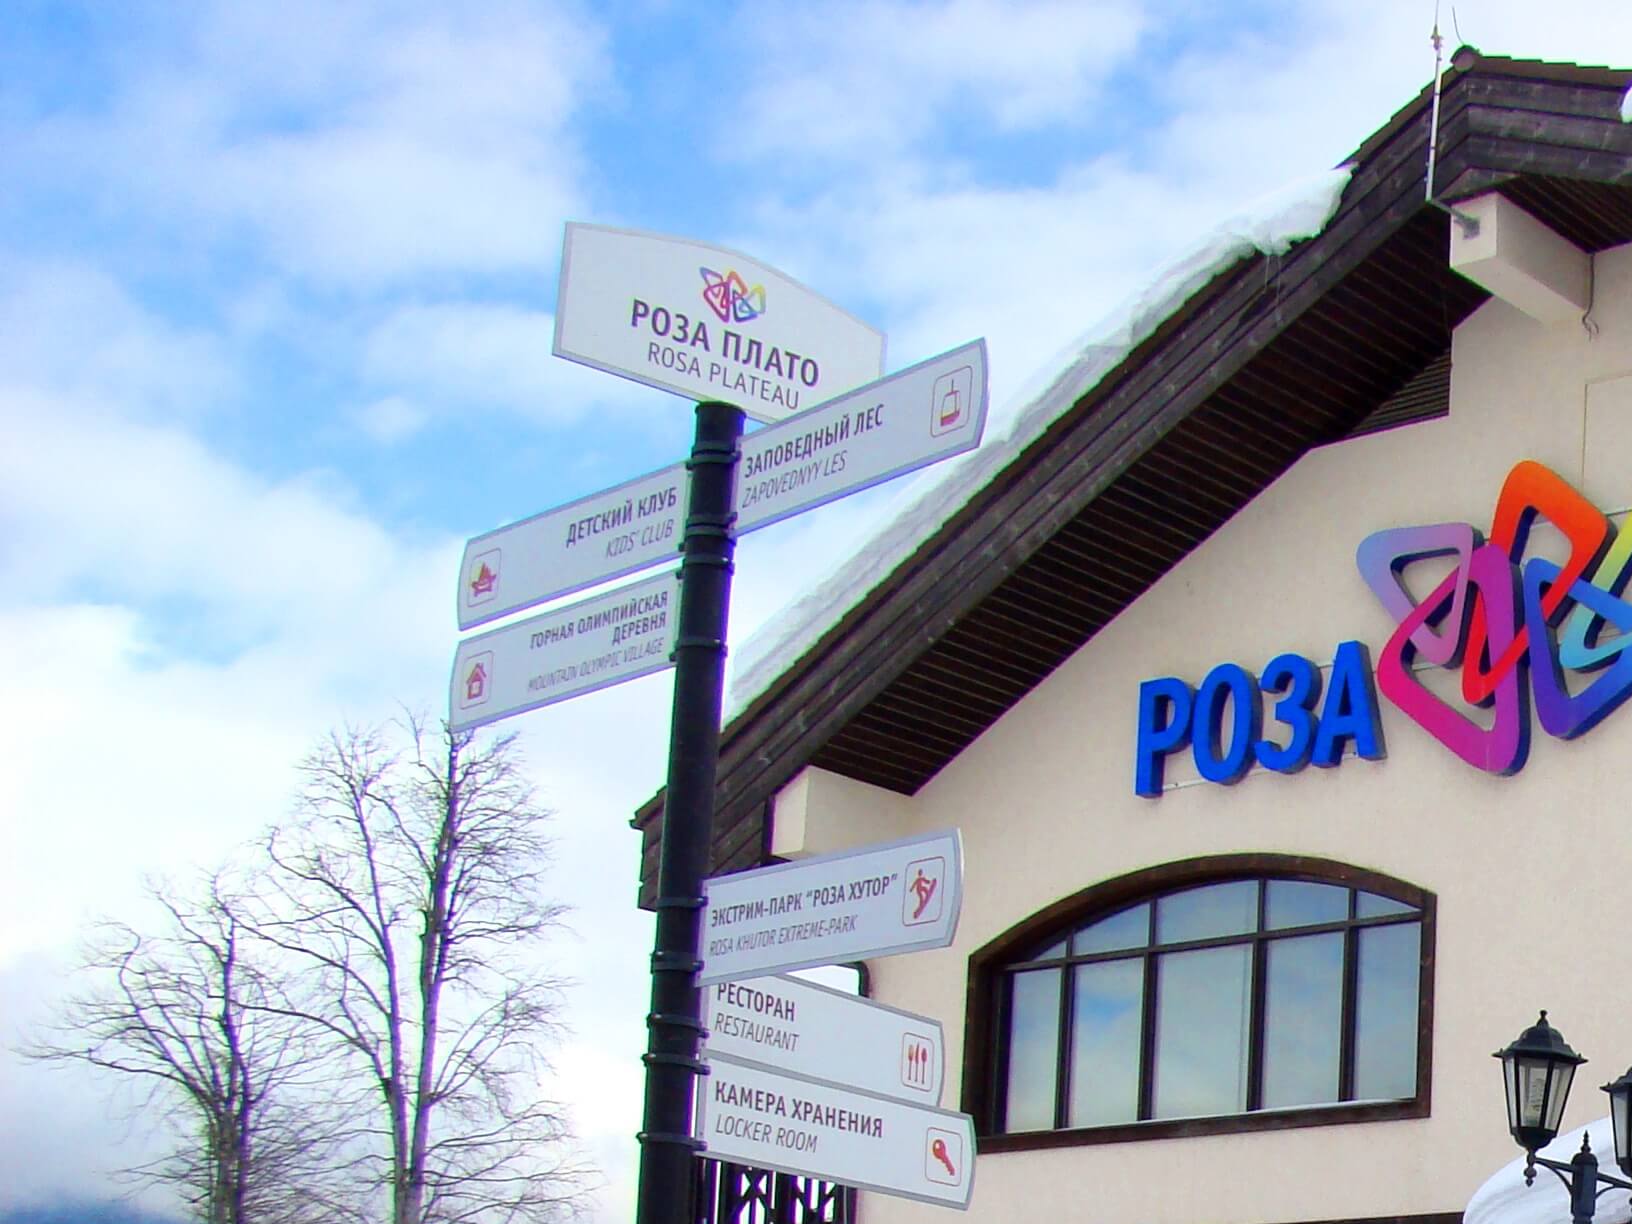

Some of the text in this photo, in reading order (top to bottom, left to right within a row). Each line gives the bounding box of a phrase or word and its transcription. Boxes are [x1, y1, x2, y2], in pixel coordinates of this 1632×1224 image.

[631, 298, 819, 387] РОЗА ПЛАТО
[647, 342, 799, 411] ROSA PLATEAU
[745, 403, 884, 478] ЗАПОВЕДНЫЙ ЛЕС
[742, 451, 847, 508] ZAPOVEDNYY LES
[566, 486, 677, 548] ДЕТСКИЙ КЛУБ
[641, 519, 675, 547] CLUB
[530, 591, 668, 650] ГОРНАЯ ОЛИМПИЙСКАЯ
[612, 611, 666, 646] ДЕРЕВНЯ
[579, 650, 622, 678] OLYMPIC
[624, 637, 664, 664] VILLAGE
[1134, 639, 1386, 798] РОЗА
[710, 914, 858, 956] ROSA KHUTOR EXTREME-PARK
[711, 893, 803, 928] ЭКСТРИМ-ПАРК
[717, 982, 796, 1023] РЕСТОРАН
[714, 1012, 799, 1053] RESTAURANT
[715, 1080, 883, 1139] КАМЕРА ХРАНЕНИЯ
[715, 1118, 818, 1153] LOCKER ROOM
